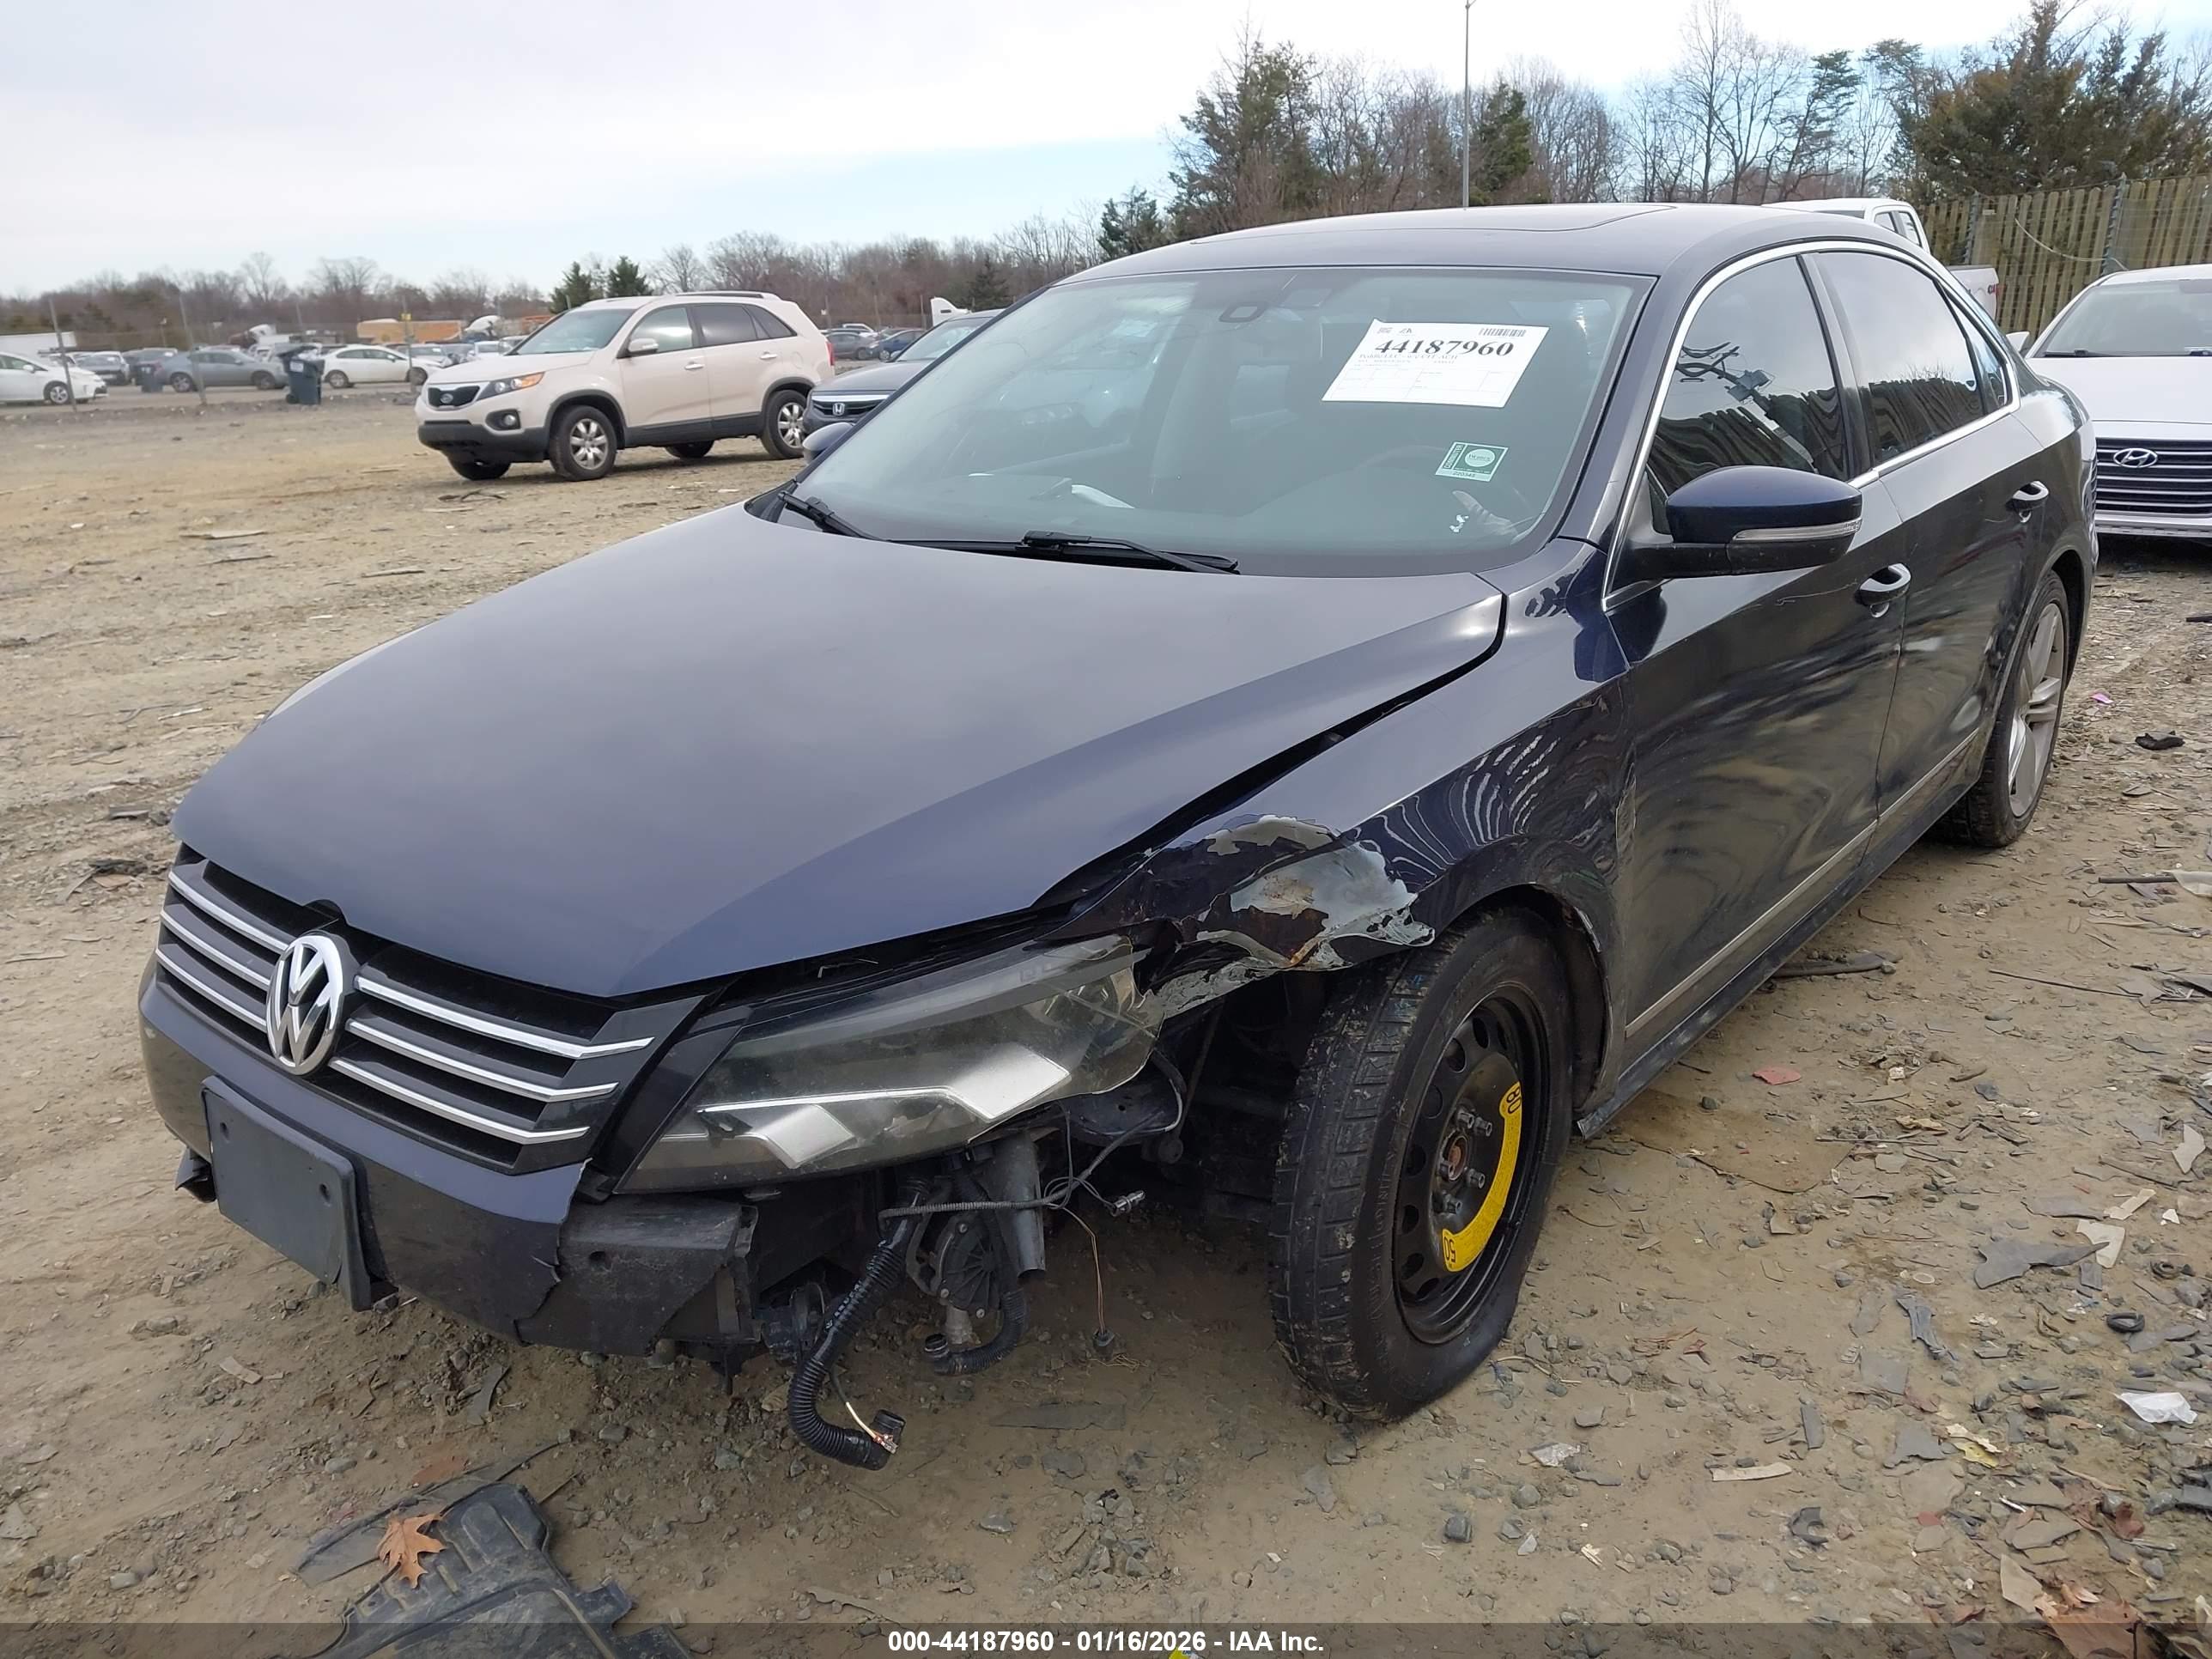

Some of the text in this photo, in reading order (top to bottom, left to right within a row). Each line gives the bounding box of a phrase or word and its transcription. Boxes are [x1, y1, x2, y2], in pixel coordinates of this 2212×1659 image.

[1375, 339, 1515, 356] 44187960
[1443, 445, 1464, 469] COMMUTER
[1506, 1086, 1522, 1114] 80
[1443, 1236, 1456, 1263] 50
